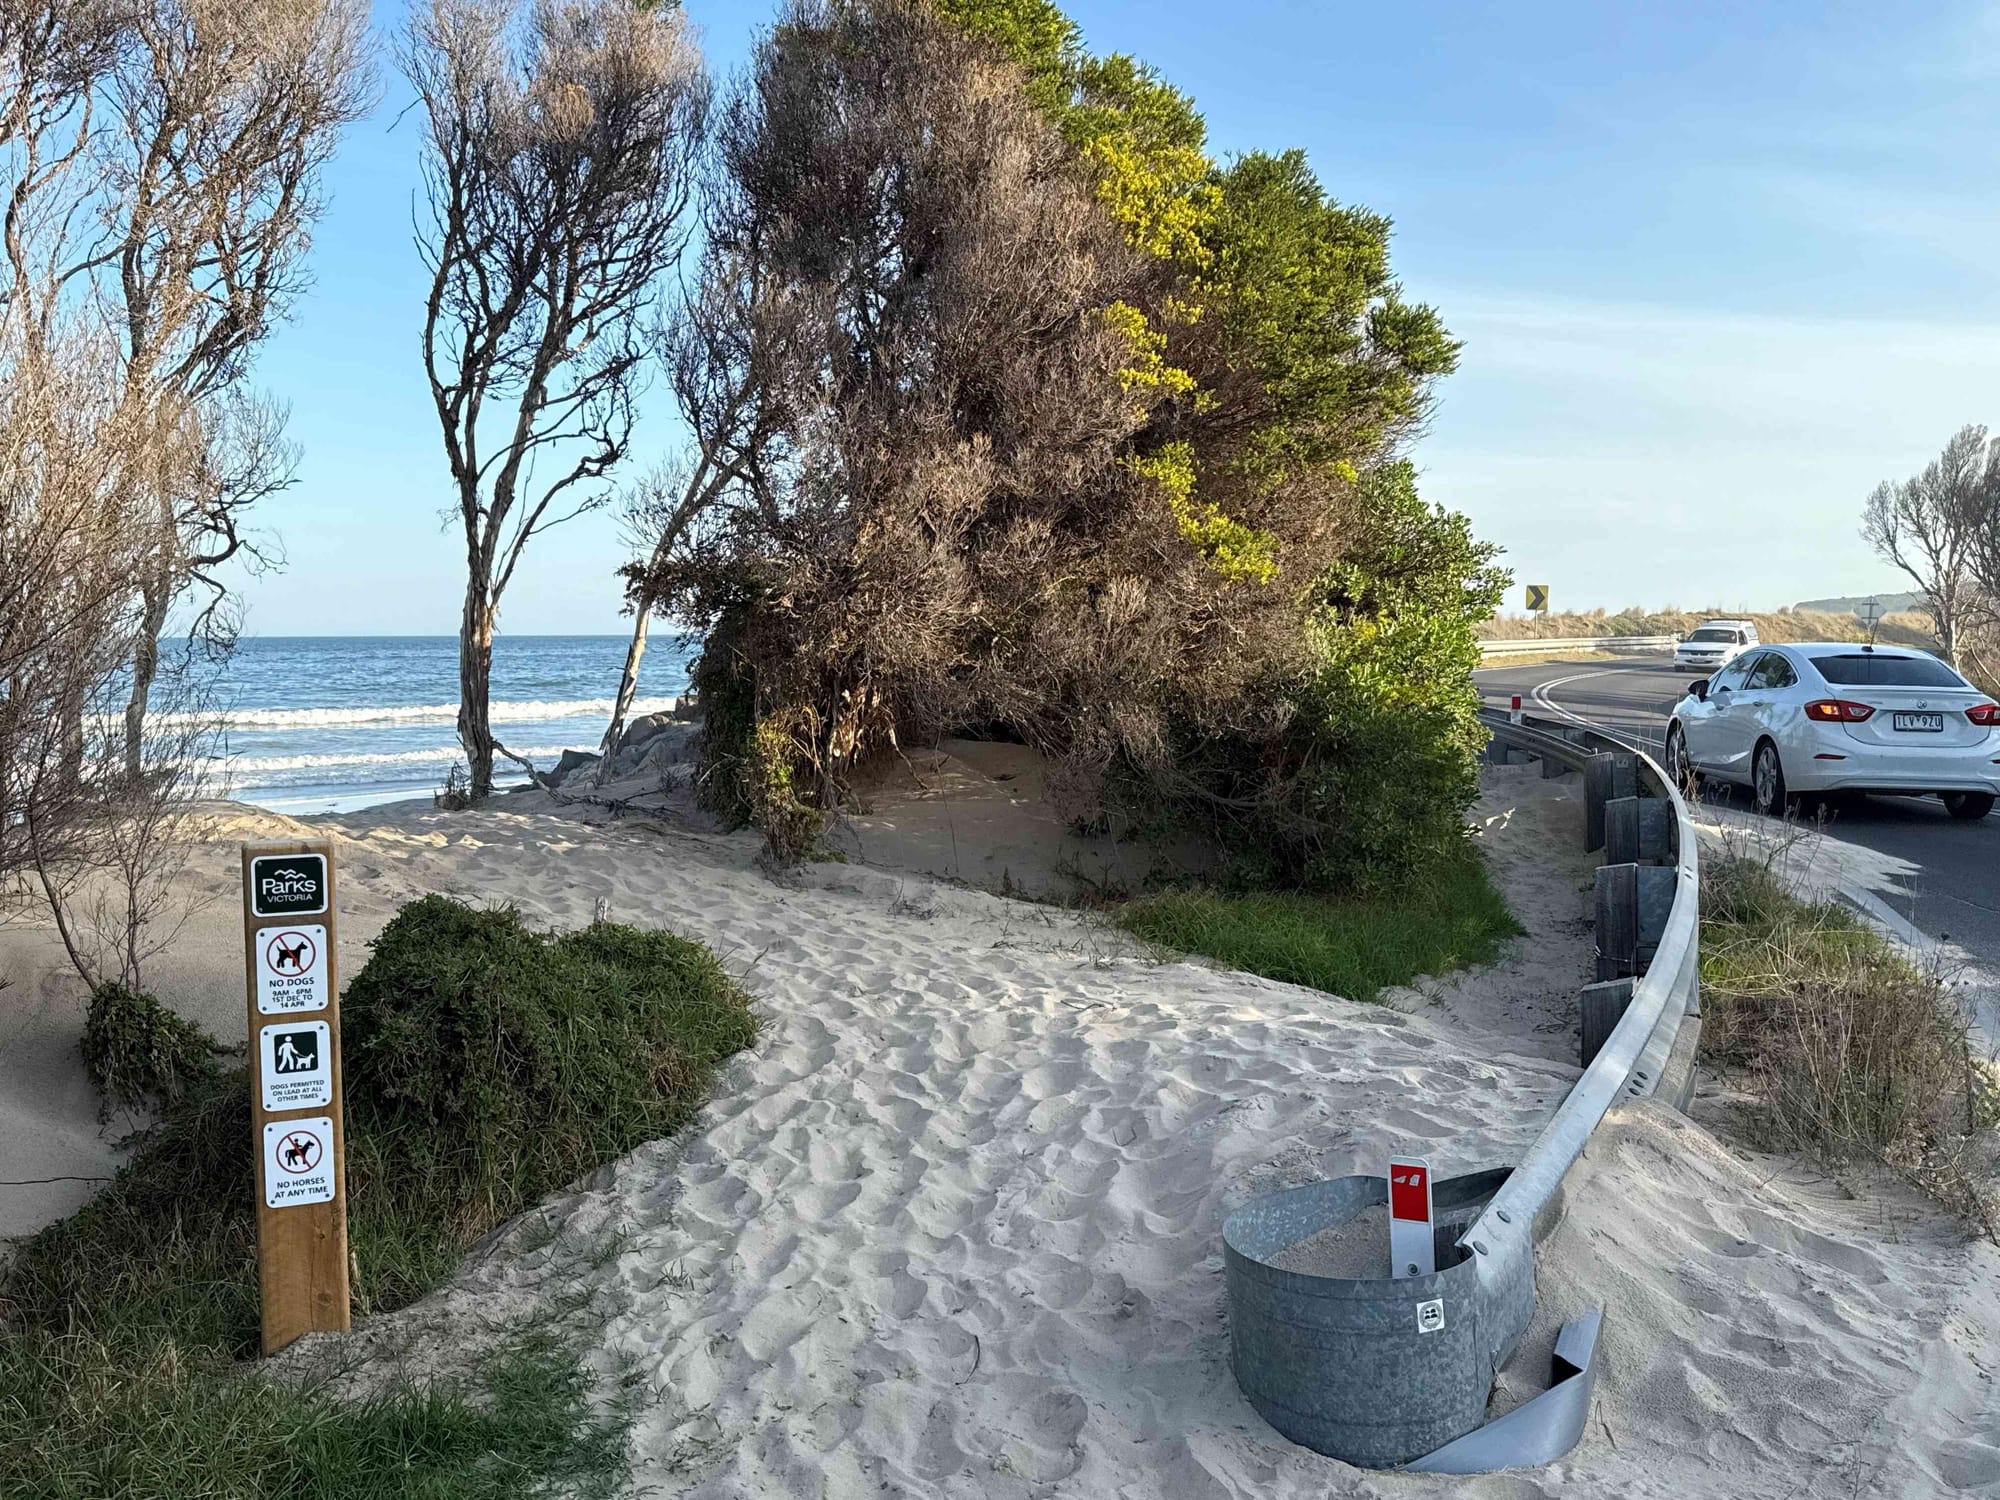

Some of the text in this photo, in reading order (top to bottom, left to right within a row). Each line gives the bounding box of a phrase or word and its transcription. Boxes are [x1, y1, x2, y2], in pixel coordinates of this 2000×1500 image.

[262, 878, 317, 895] Parks
[266, 893, 313, 903] VICTORIA
[287, 977, 315, 986] DOGS
[290, 1079, 325, 1088] PERMITTED
[277, 1176, 325, 1189] NO HORSES
[287, 1188, 306, 1197] ANY
[308, 1186, 328, 1194] TIME
